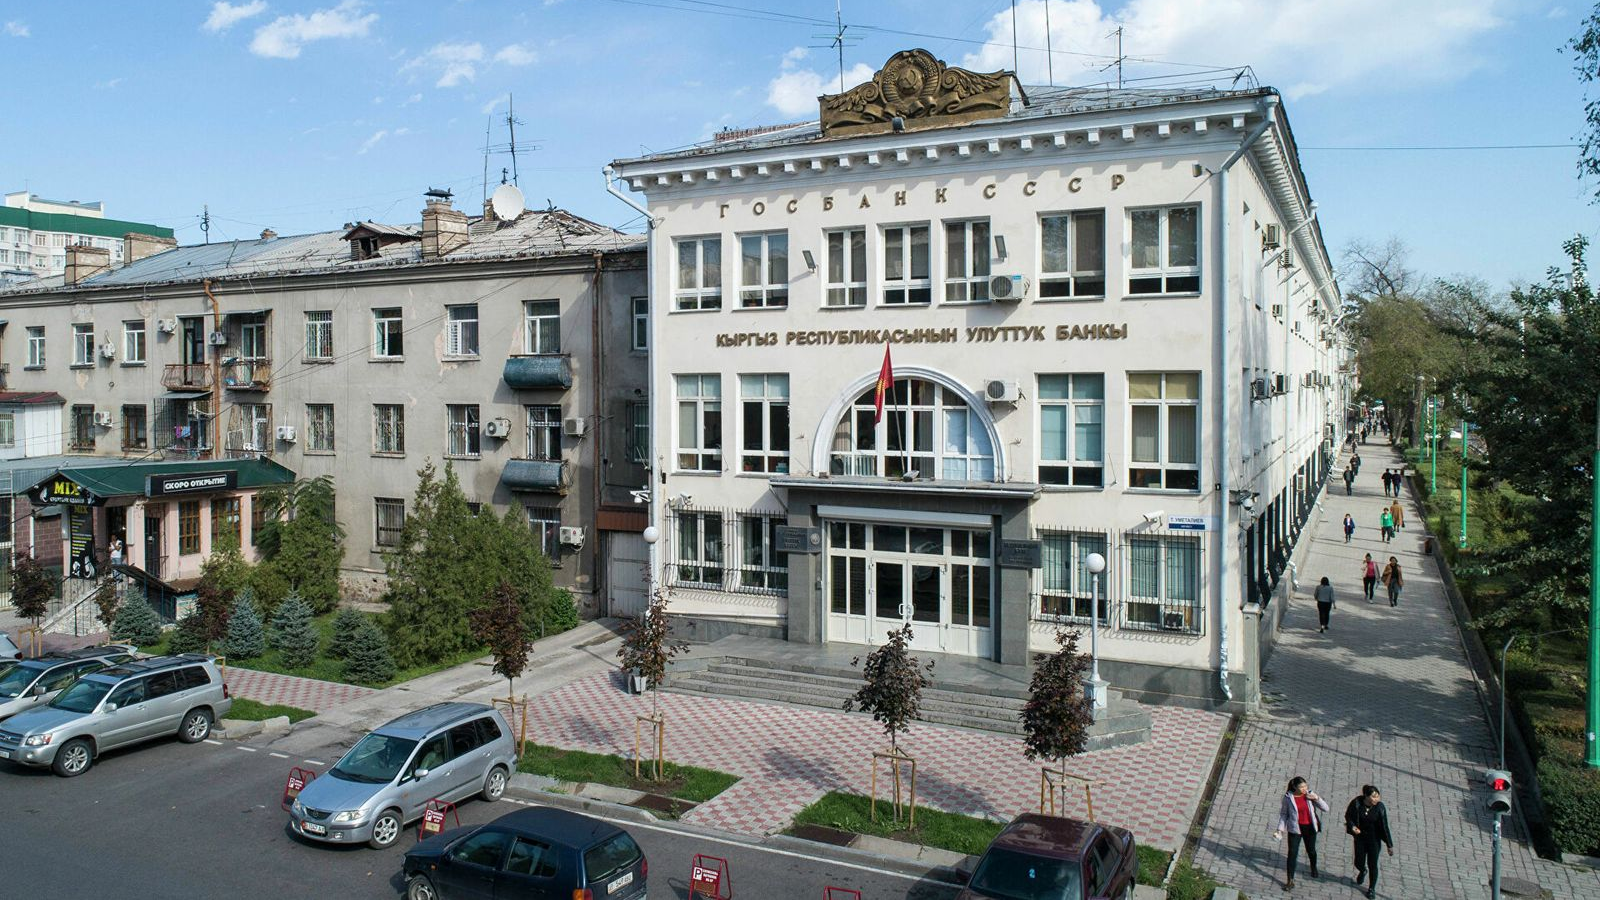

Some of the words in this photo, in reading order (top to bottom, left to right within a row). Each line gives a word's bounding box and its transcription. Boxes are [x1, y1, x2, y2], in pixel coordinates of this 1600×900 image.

[720, 189, 947, 218] ГОСБАНК
[983, 173, 1125, 199] СССР
[716, 332, 779, 347] КЫРГЫЗ
[786, 326, 957, 345] РЕСПУБЛИКАСЫНЫН
[966, 325, 1046, 343] УЛУТТУК
[1055, 323, 1128, 341] БАНКЫ
[53, 481, 80, 495] MIX
[165, 481, 189, 489] СКОРО
[190, 477, 226, 487] ОТКРЫТИЕ
